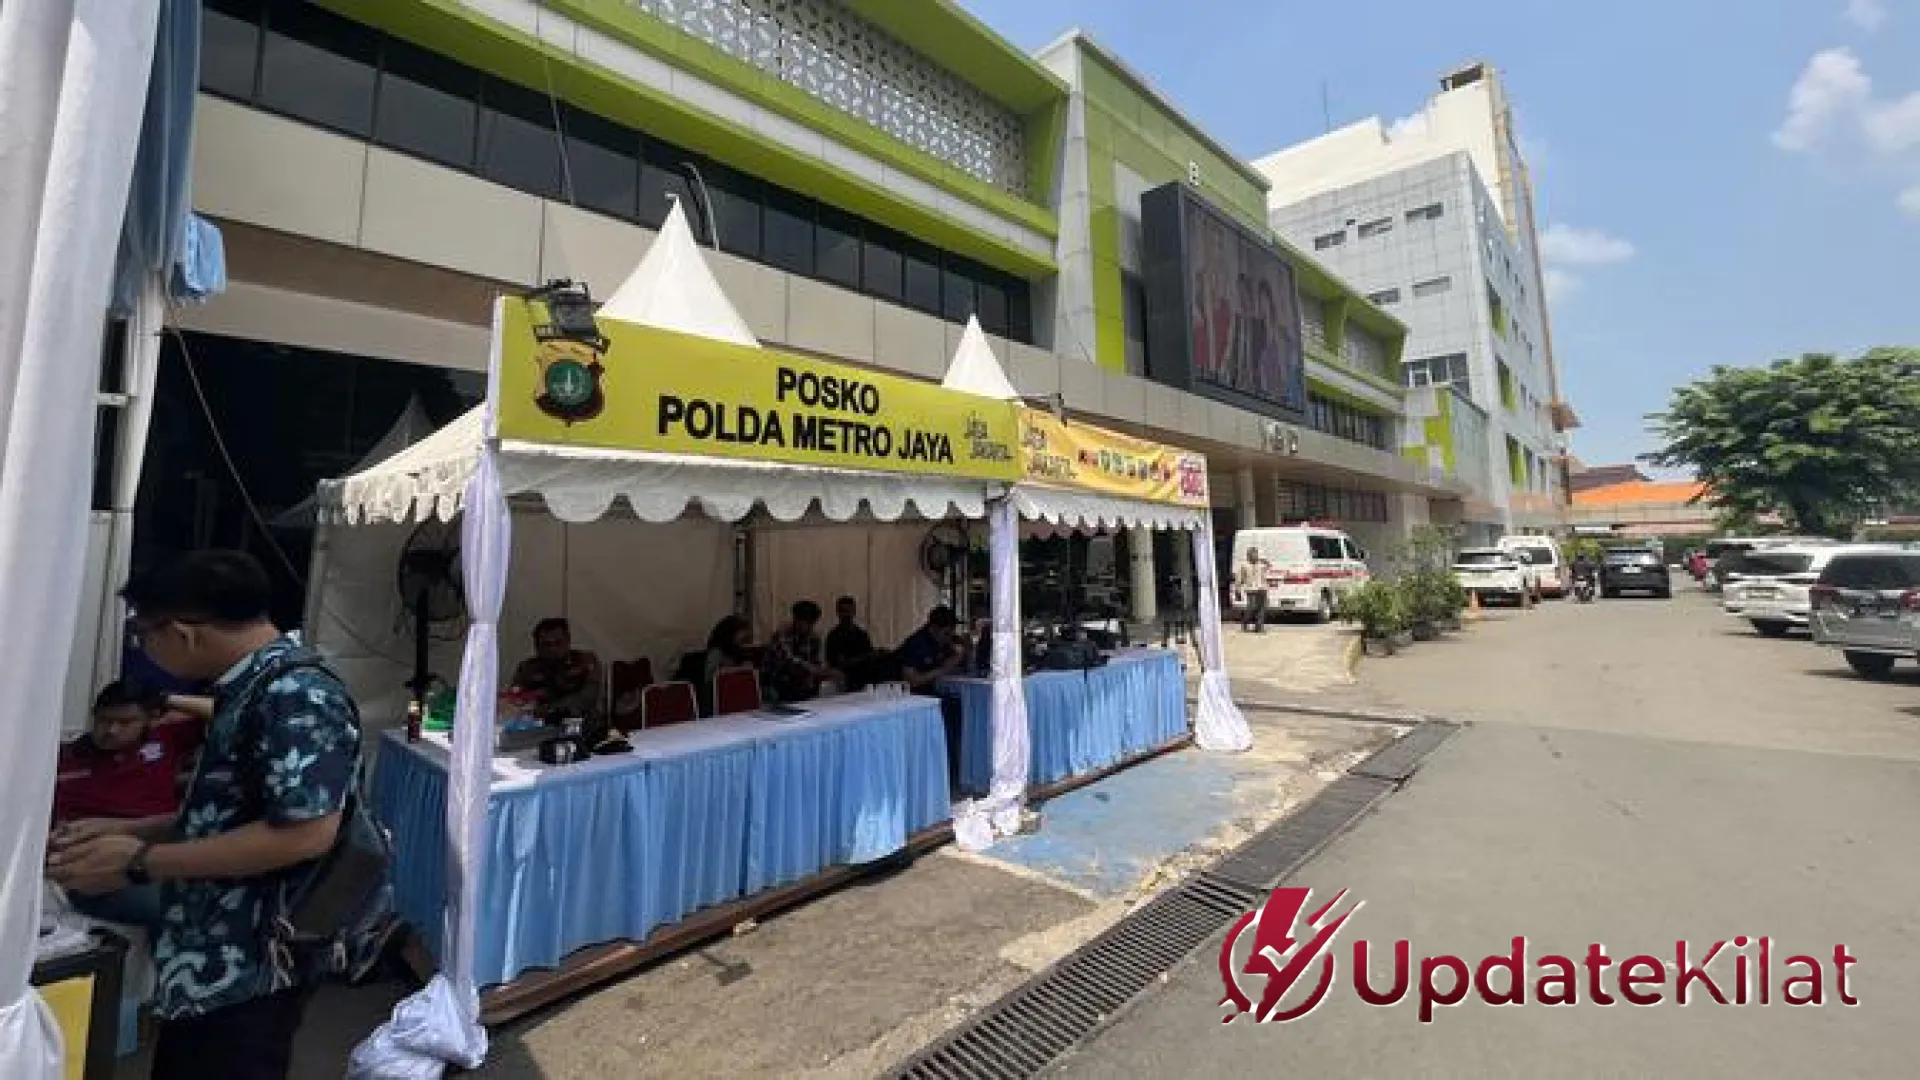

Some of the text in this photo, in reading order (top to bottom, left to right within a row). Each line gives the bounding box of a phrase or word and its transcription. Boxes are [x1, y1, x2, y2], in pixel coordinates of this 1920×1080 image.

[776, 366, 880, 416] POSKO
[657, 395, 785, 447] POLDA
[792, 413, 892, 457] METRO
[898, 429, 954, 464] JAYA
